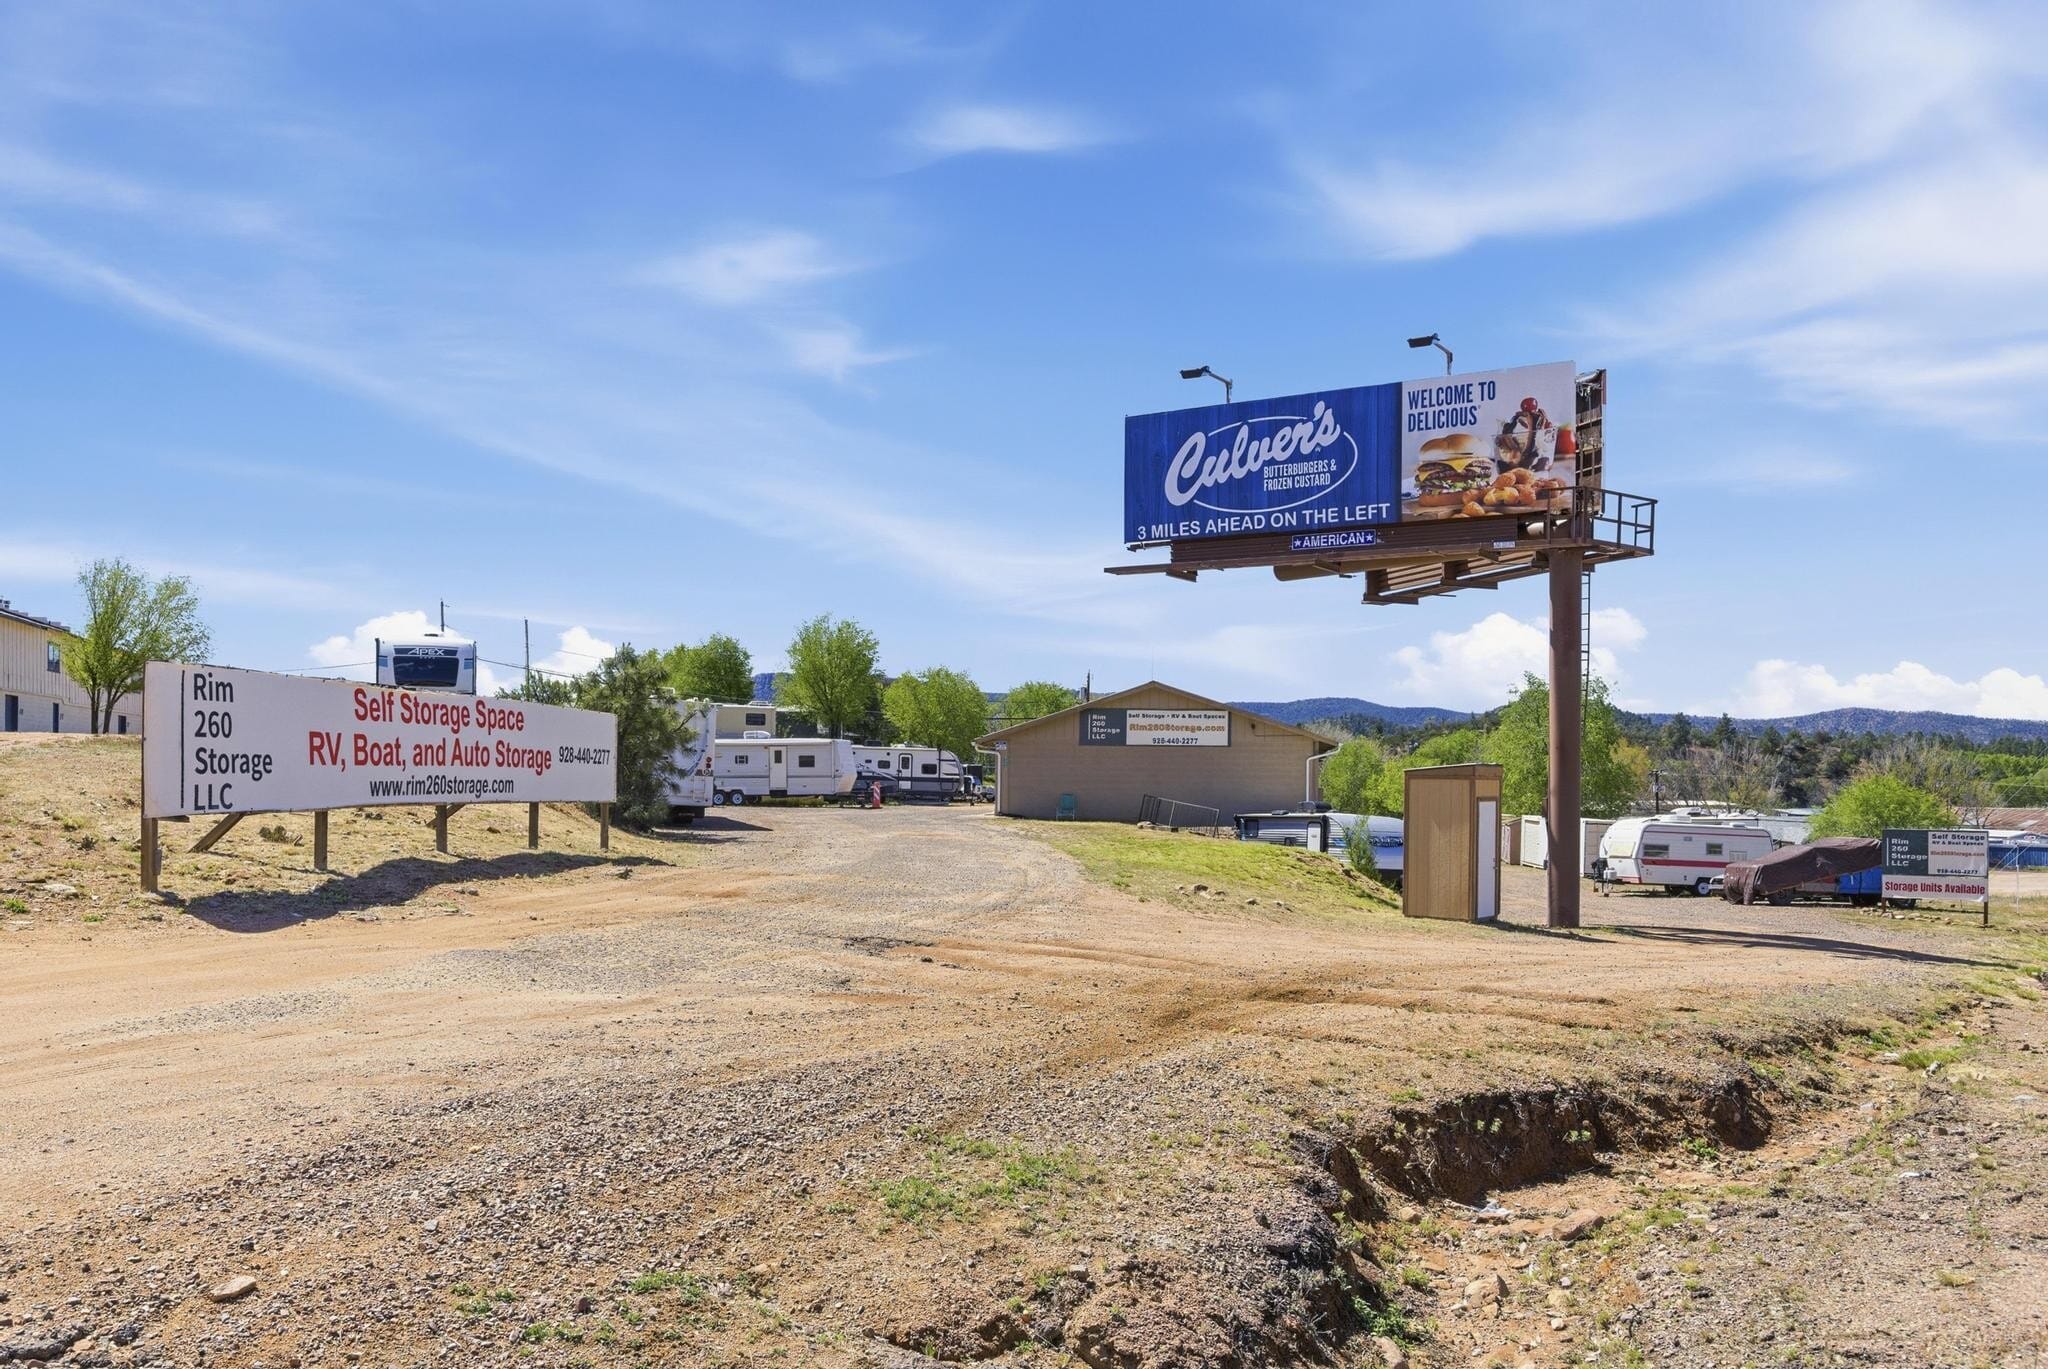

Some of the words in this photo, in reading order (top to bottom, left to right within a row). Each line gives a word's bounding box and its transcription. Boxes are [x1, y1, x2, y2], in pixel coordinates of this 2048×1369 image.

[1408, 383, 1473, 410] WELCOME
[1478, 380, 1496, 401] TO
[1408, 405, 1478, 432] DELICIOUS
[1164, 400, 1341, 506] Culver's
[1263, 460, 1329, 479] BUTTERBURGERS
[1330, 458, 1337, 472] &
[1263, 476, 1293, 492] FROZEN
[1294, 473, 1331, 488] CUSTARD
[1137, 526, 1147, 540] 3
[1151, 520, 1200, 539] MILES
[1205, 514, 1266, 534] AHEAD
[1270, 511, 1297, 528] ON
[1302, 507, 1339, 525] THE
[1344, 503, 1391, 521] LEFT
[1302, 532, 1365, 548] AMERICAN
[407, 647, 445, 656] APEX
[193, 672, 234, 702] Rim
[194, 710, 232, 738] 260
[354, 688, 394, 722] Self
[400, 692, 470, 734] Storage
[475, 699, 525, 735] Space
[195, 747, 273, 781] Storage
[309, 731, 346, 772] RV,
[353, 733, 406, 772] Boat,
[413, 737, 446, 767] and
[451, 738, 490, 768] Auto
[495, 740, 552, 776] Storage
[559, 746, 610, 765] 928-440-2277
[194, 783, 233, 811] LLC
[369, 775, 514, 799] www.rim260storage.com
[1951, 833, 1985, 841] Storage
[1891, 853, 1927, 861] Storage
[1884, 881, 1918, 893] Storage
[1920, 882, 1943, 893] Units
[1944, 883, 1985, 895] Available
